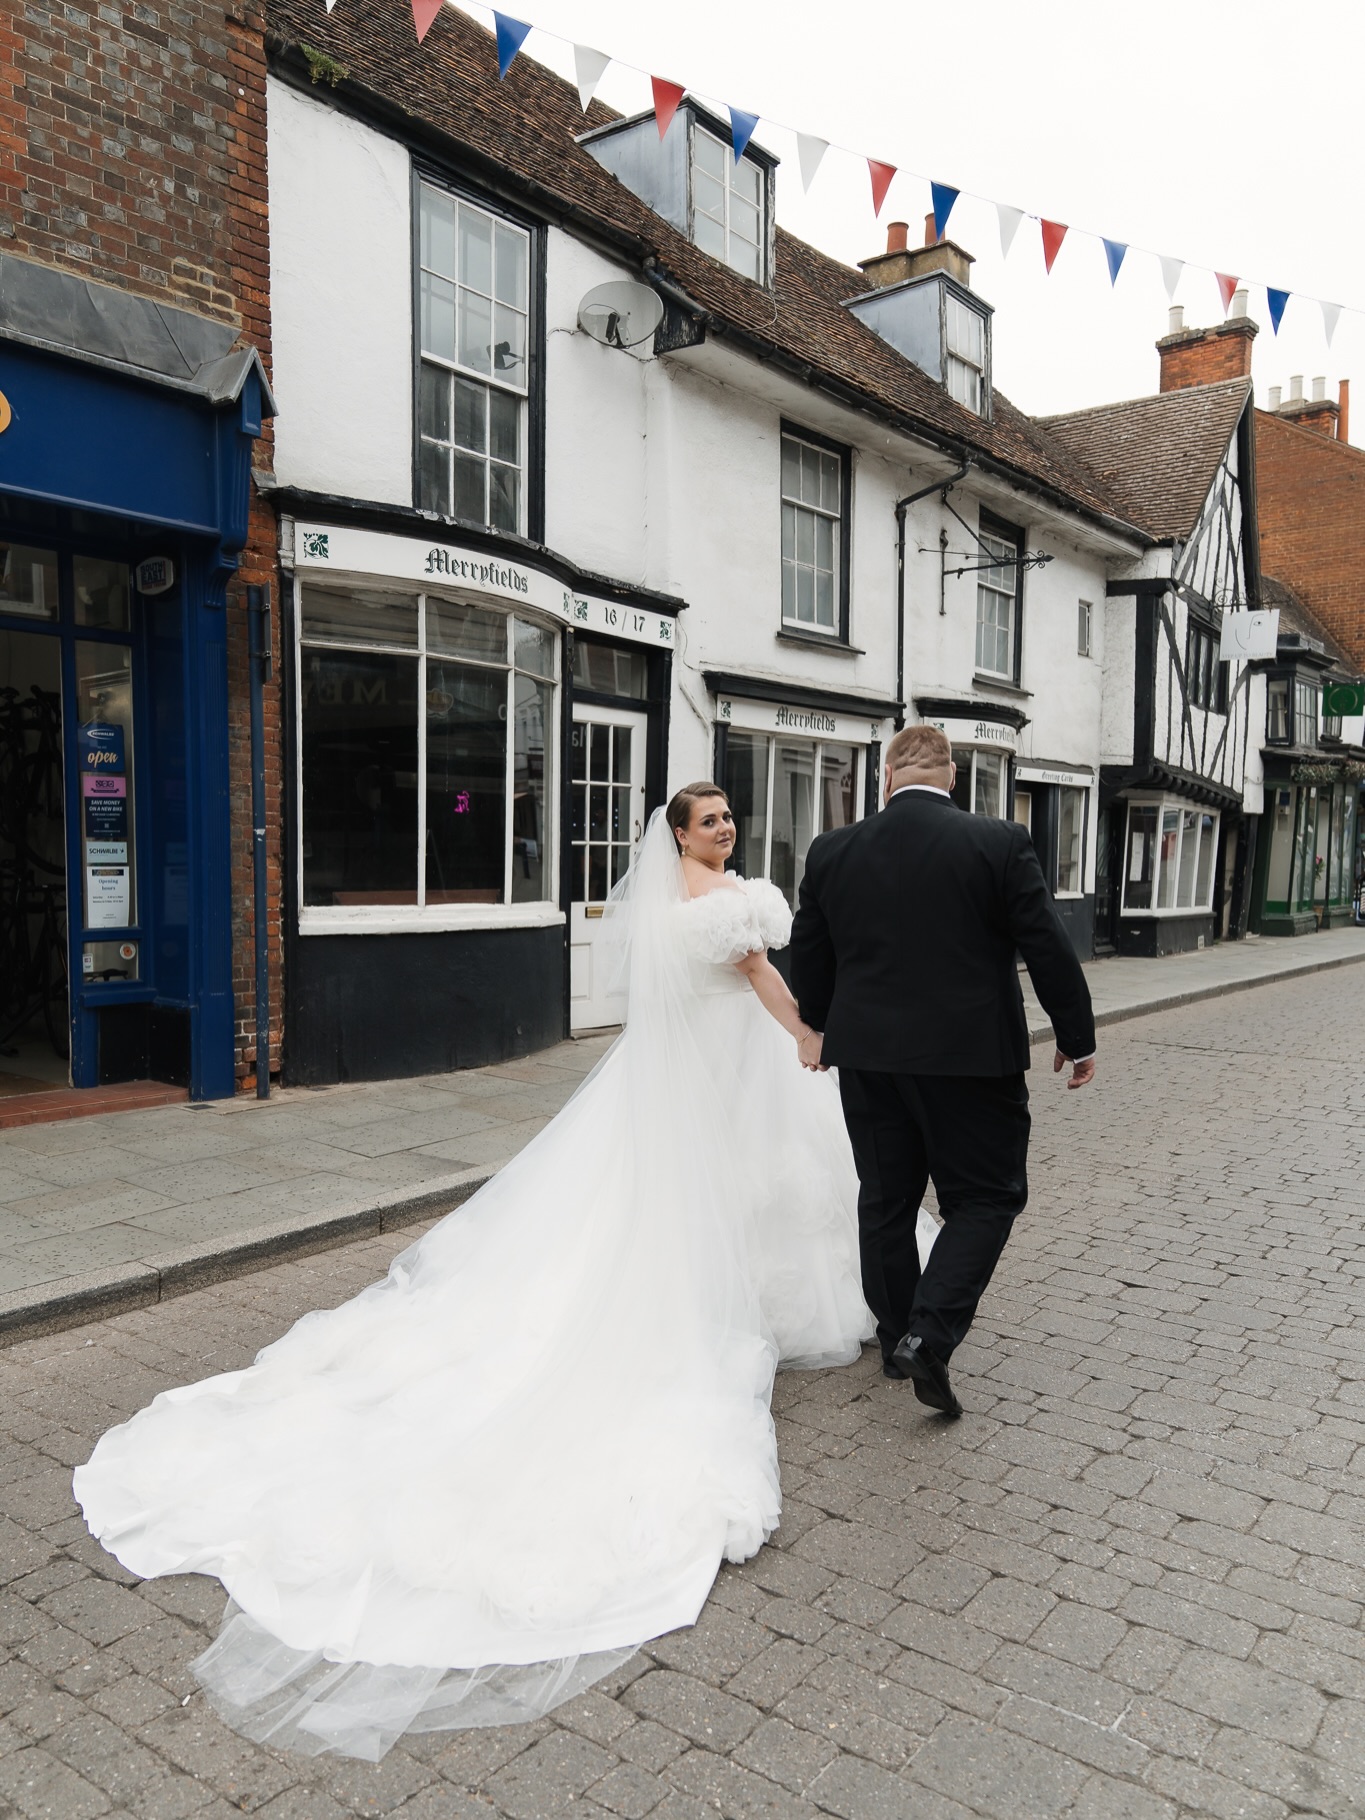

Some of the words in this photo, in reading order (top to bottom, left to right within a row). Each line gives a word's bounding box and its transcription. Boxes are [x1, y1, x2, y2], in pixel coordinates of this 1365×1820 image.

[424, 547, 529, 595] Merryfields
[604, 606, 618, 626] 16
[633, 614, 646, 633] 17
[775, 705, 837, 733] Merryfields
[88, 751, 118, 768] open
